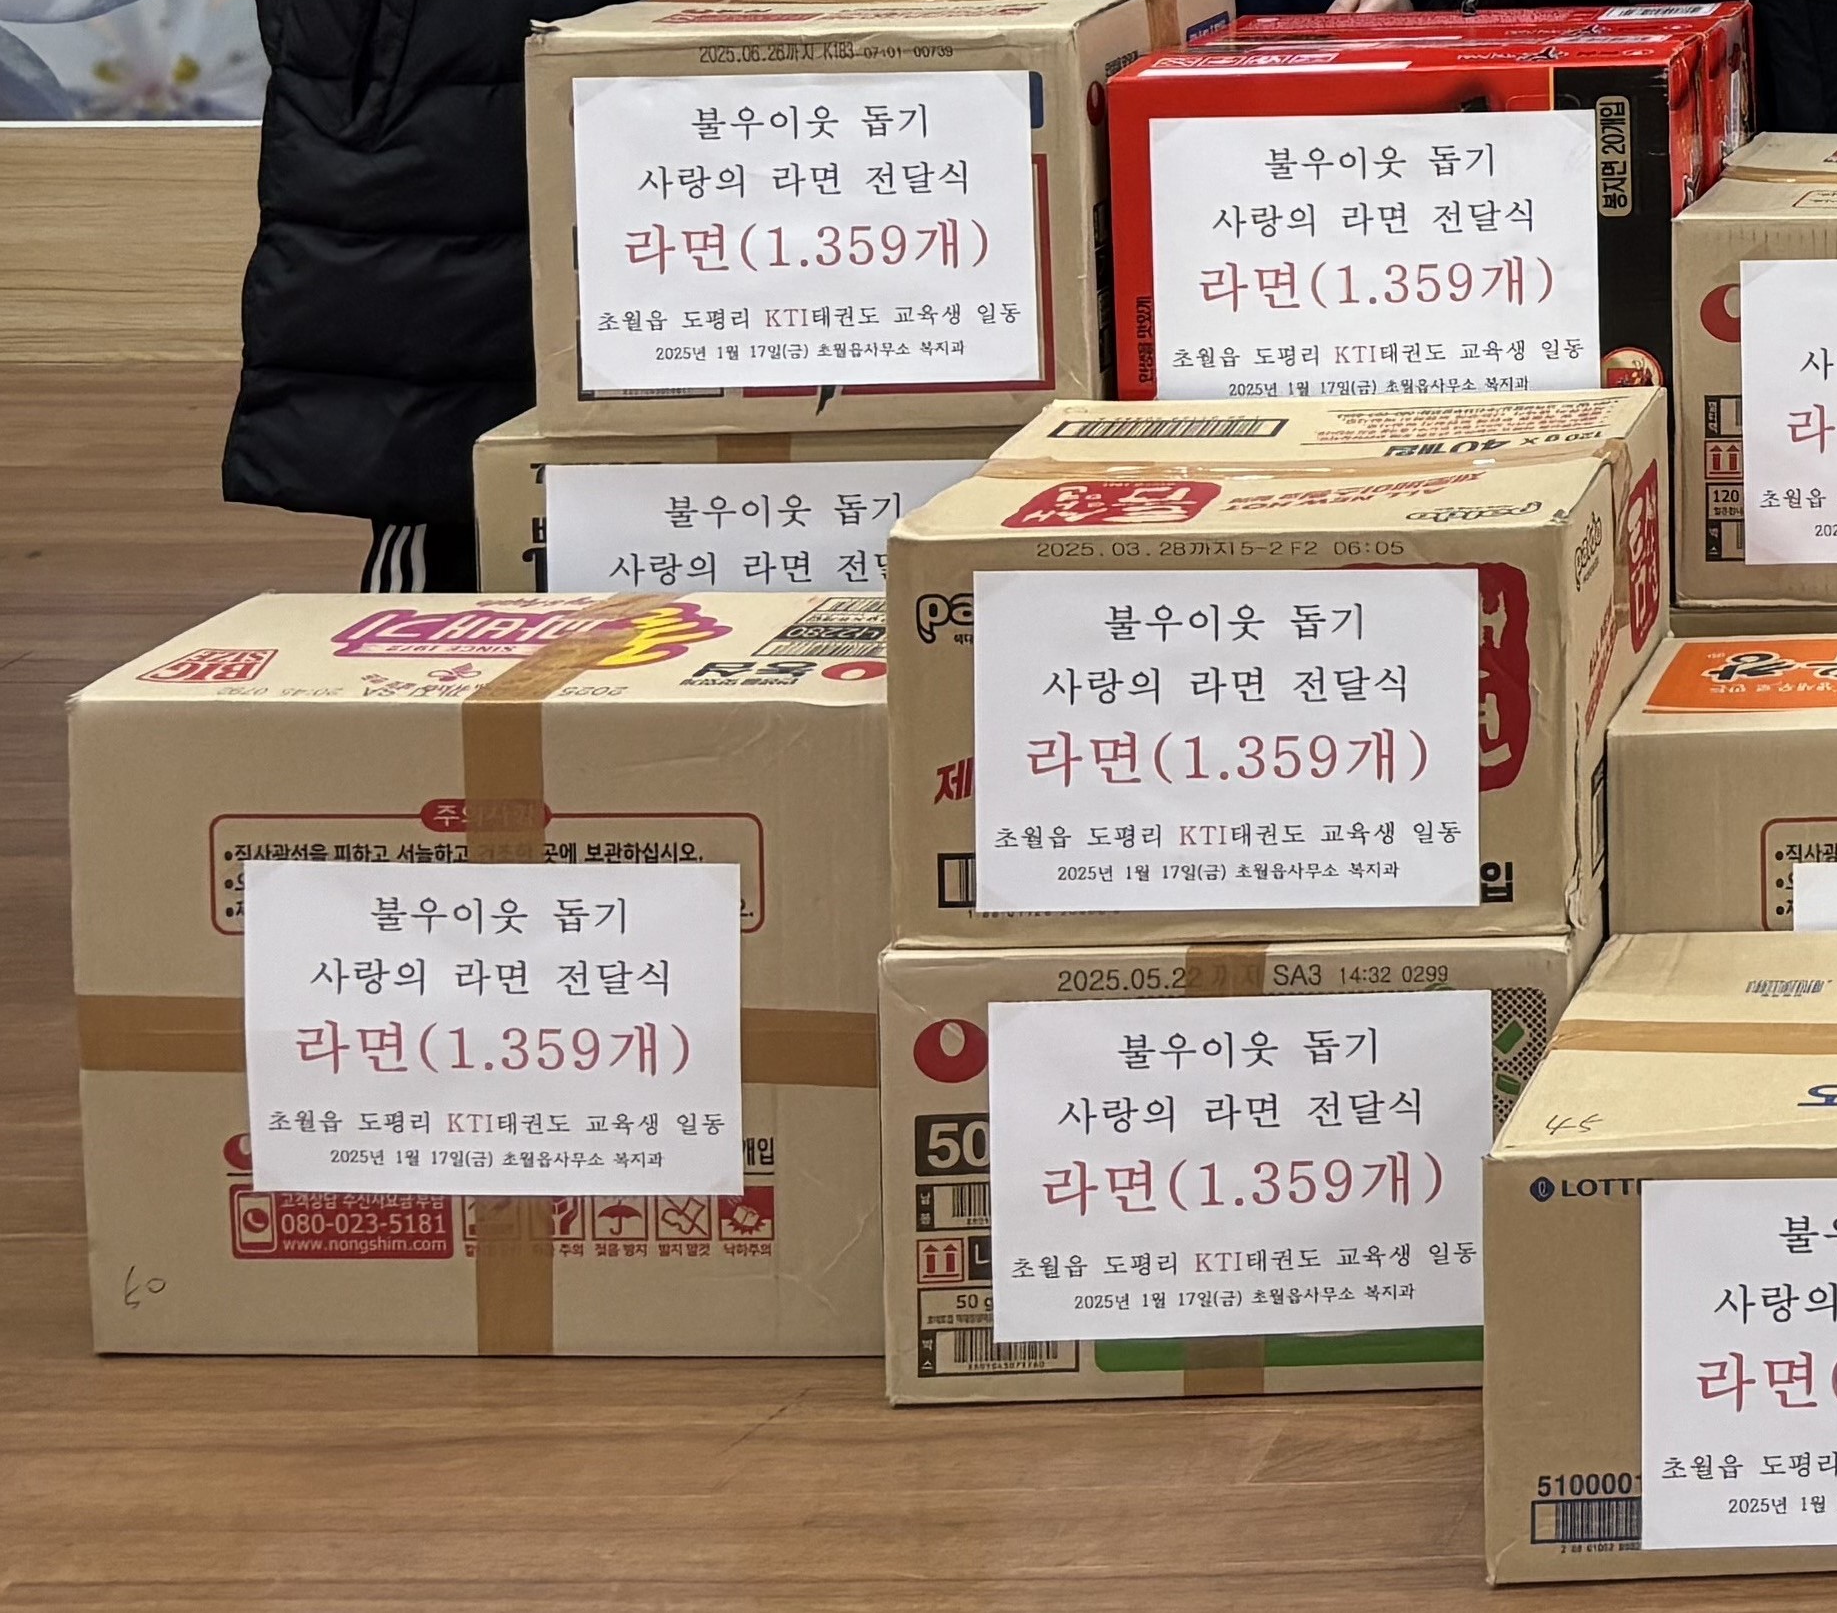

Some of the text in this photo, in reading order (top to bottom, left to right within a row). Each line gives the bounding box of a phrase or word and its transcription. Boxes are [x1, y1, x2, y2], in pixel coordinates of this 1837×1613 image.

[691, 103, 927, 142] 불우이웃 돕기
[1264, 142, 1494, 181] 불우이웃 돕기
[1600, 102, 1628, 211] 봉지면 20개입
[624, 217, 988, 276] 라면(1.359개)
[1199, 255, 1553, 313] 라면(1.359개)
[664, 492, 901, 529] 불우이웃 돕기
[1712, 489, 1740, 504] 120
[1333, 538, 1404, 556] 06:05
[1103, 602, 1363, 643] 불우이웃 돕기
[149, 662, 256, 682] BIG
[181, 651, 268, 663] SIZE
[693, 660, 818, 679] 농심
[1026, 727, 1428, 788] 라면(1.359개)
[334, 843, 390, 863] 피하고
[1273, 963, 1449, 987] SA3 14:32 0299
[295, 1019, 690, 1077] 라면(1.359개)
[1057, 1087, 1421, 1136] 사랑의 라면 전달식
[1042, 1150, 1442, 1217] 라면(1.359개)
[281, 1212, 447, 1236] 080-023-5181
[282, 1237, 448, 1255] www.nongshim.com
